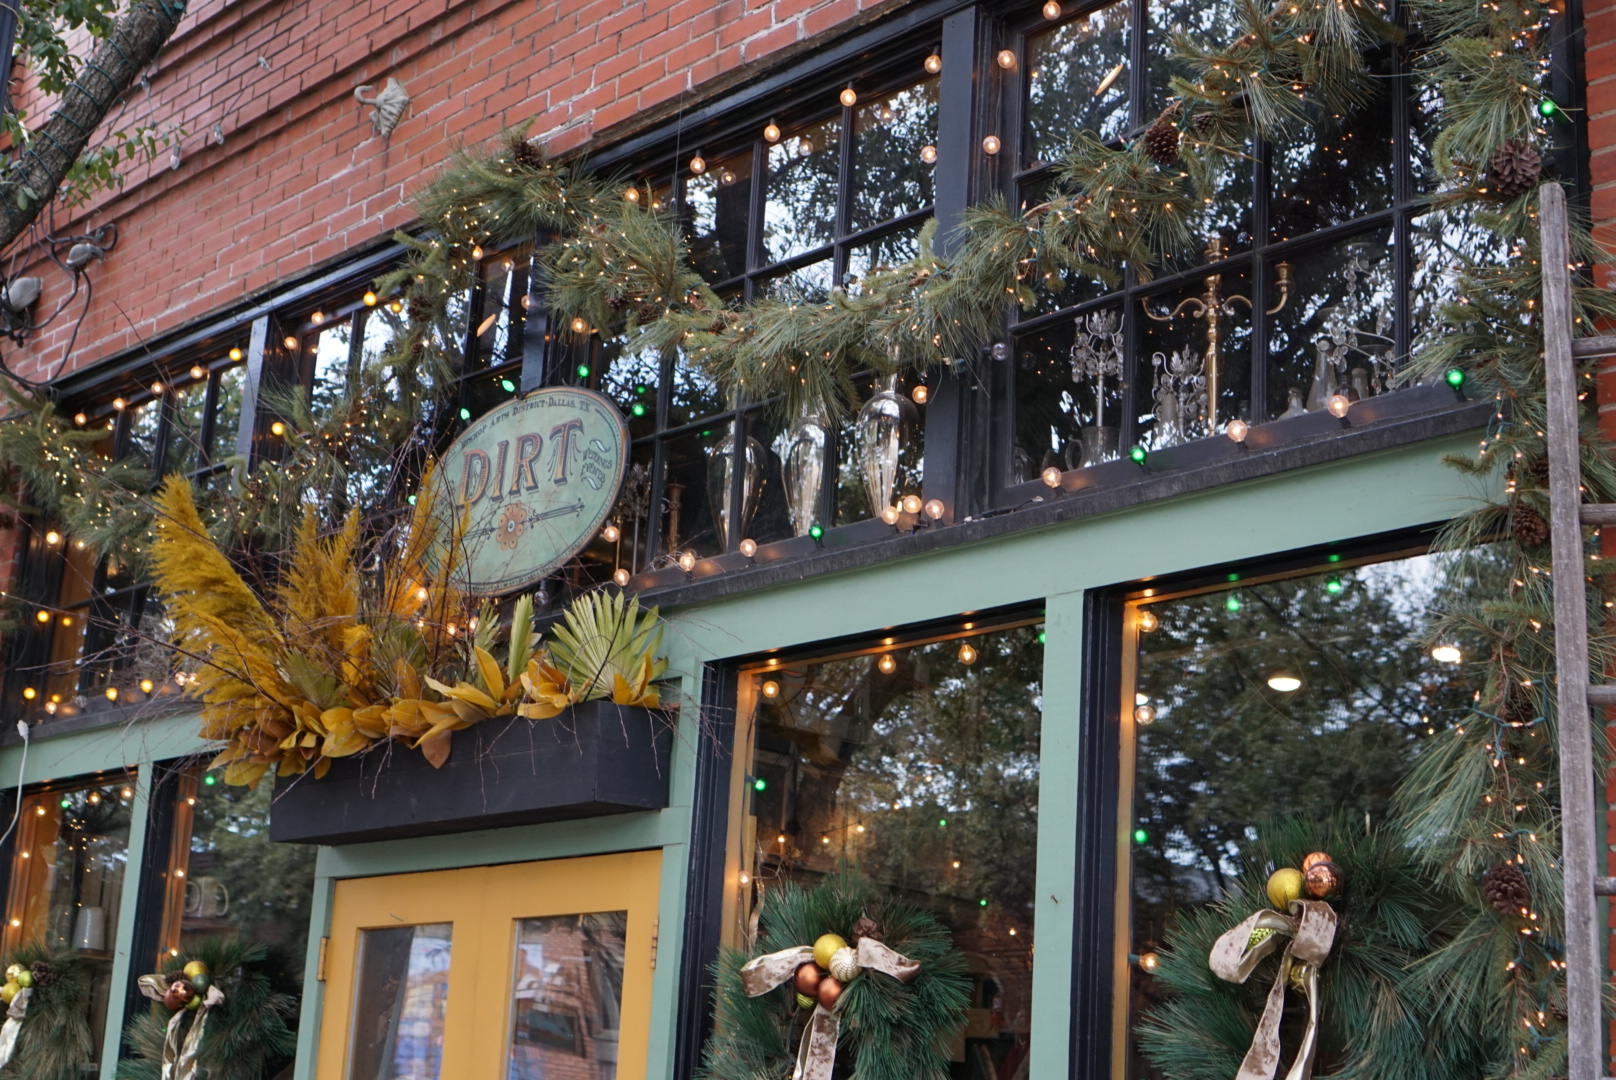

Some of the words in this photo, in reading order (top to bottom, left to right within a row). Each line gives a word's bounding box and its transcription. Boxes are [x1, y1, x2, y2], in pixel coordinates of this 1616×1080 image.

[490, 412, 509, 428] ARTS
[513, 399, 545, 416] DISTRICT
[579, 401, 590, 412] TX
[456, 418, 584, 510] DIRT
[582, 448, 613, 469] WEDDINGS
